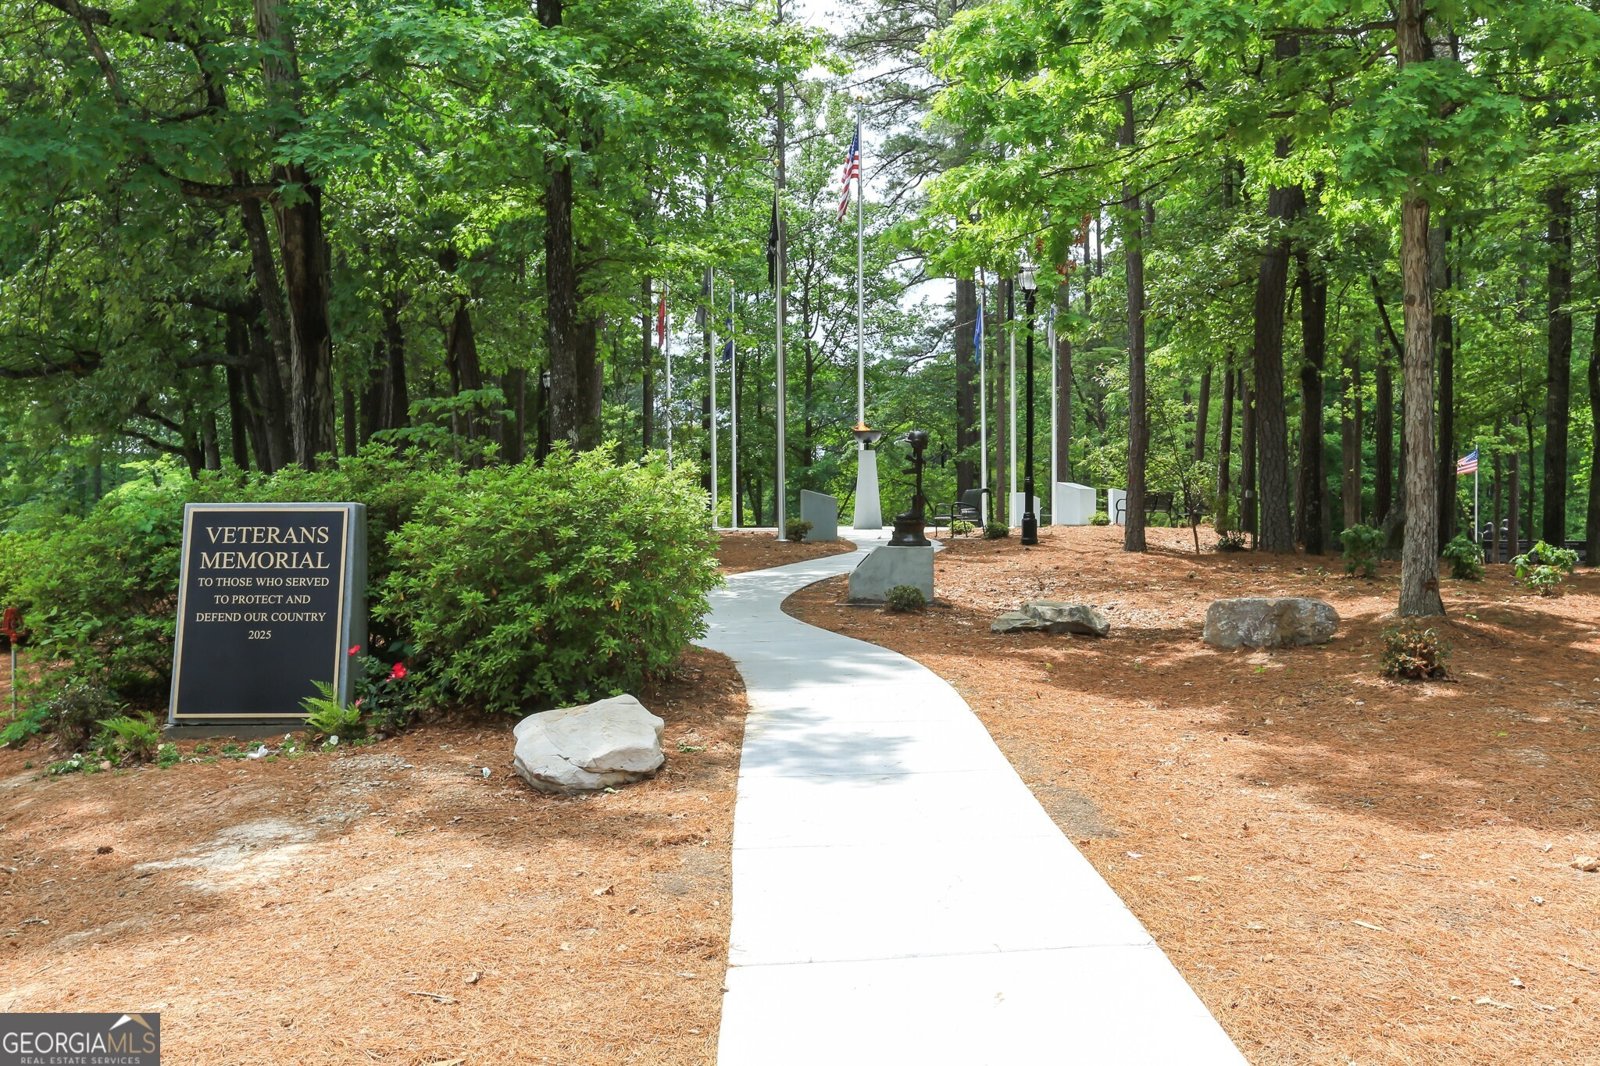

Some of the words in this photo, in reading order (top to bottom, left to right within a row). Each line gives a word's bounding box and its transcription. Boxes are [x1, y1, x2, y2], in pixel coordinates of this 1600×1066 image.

[206, 526, 329, 544] VETERANS
[200, 551, 330, 569] MEMORIAL
[198, 578, 213, 586] TO
[216, 578, 252, 586] THOSE
[256, 578, 283, 586] WHO
[285, 578, 329, 586] SERVED
[214, 595, 229, 604] TO
[232, 595, 283, 604] PROTECT
[286, 595, 310, 604] AND
[196, 613, 241, 622] DEFEND
[244, 613, 268, 622] OUR
[271, 612, 326, 622] COUNTRY
[248, 631, 272, 639] 2025
